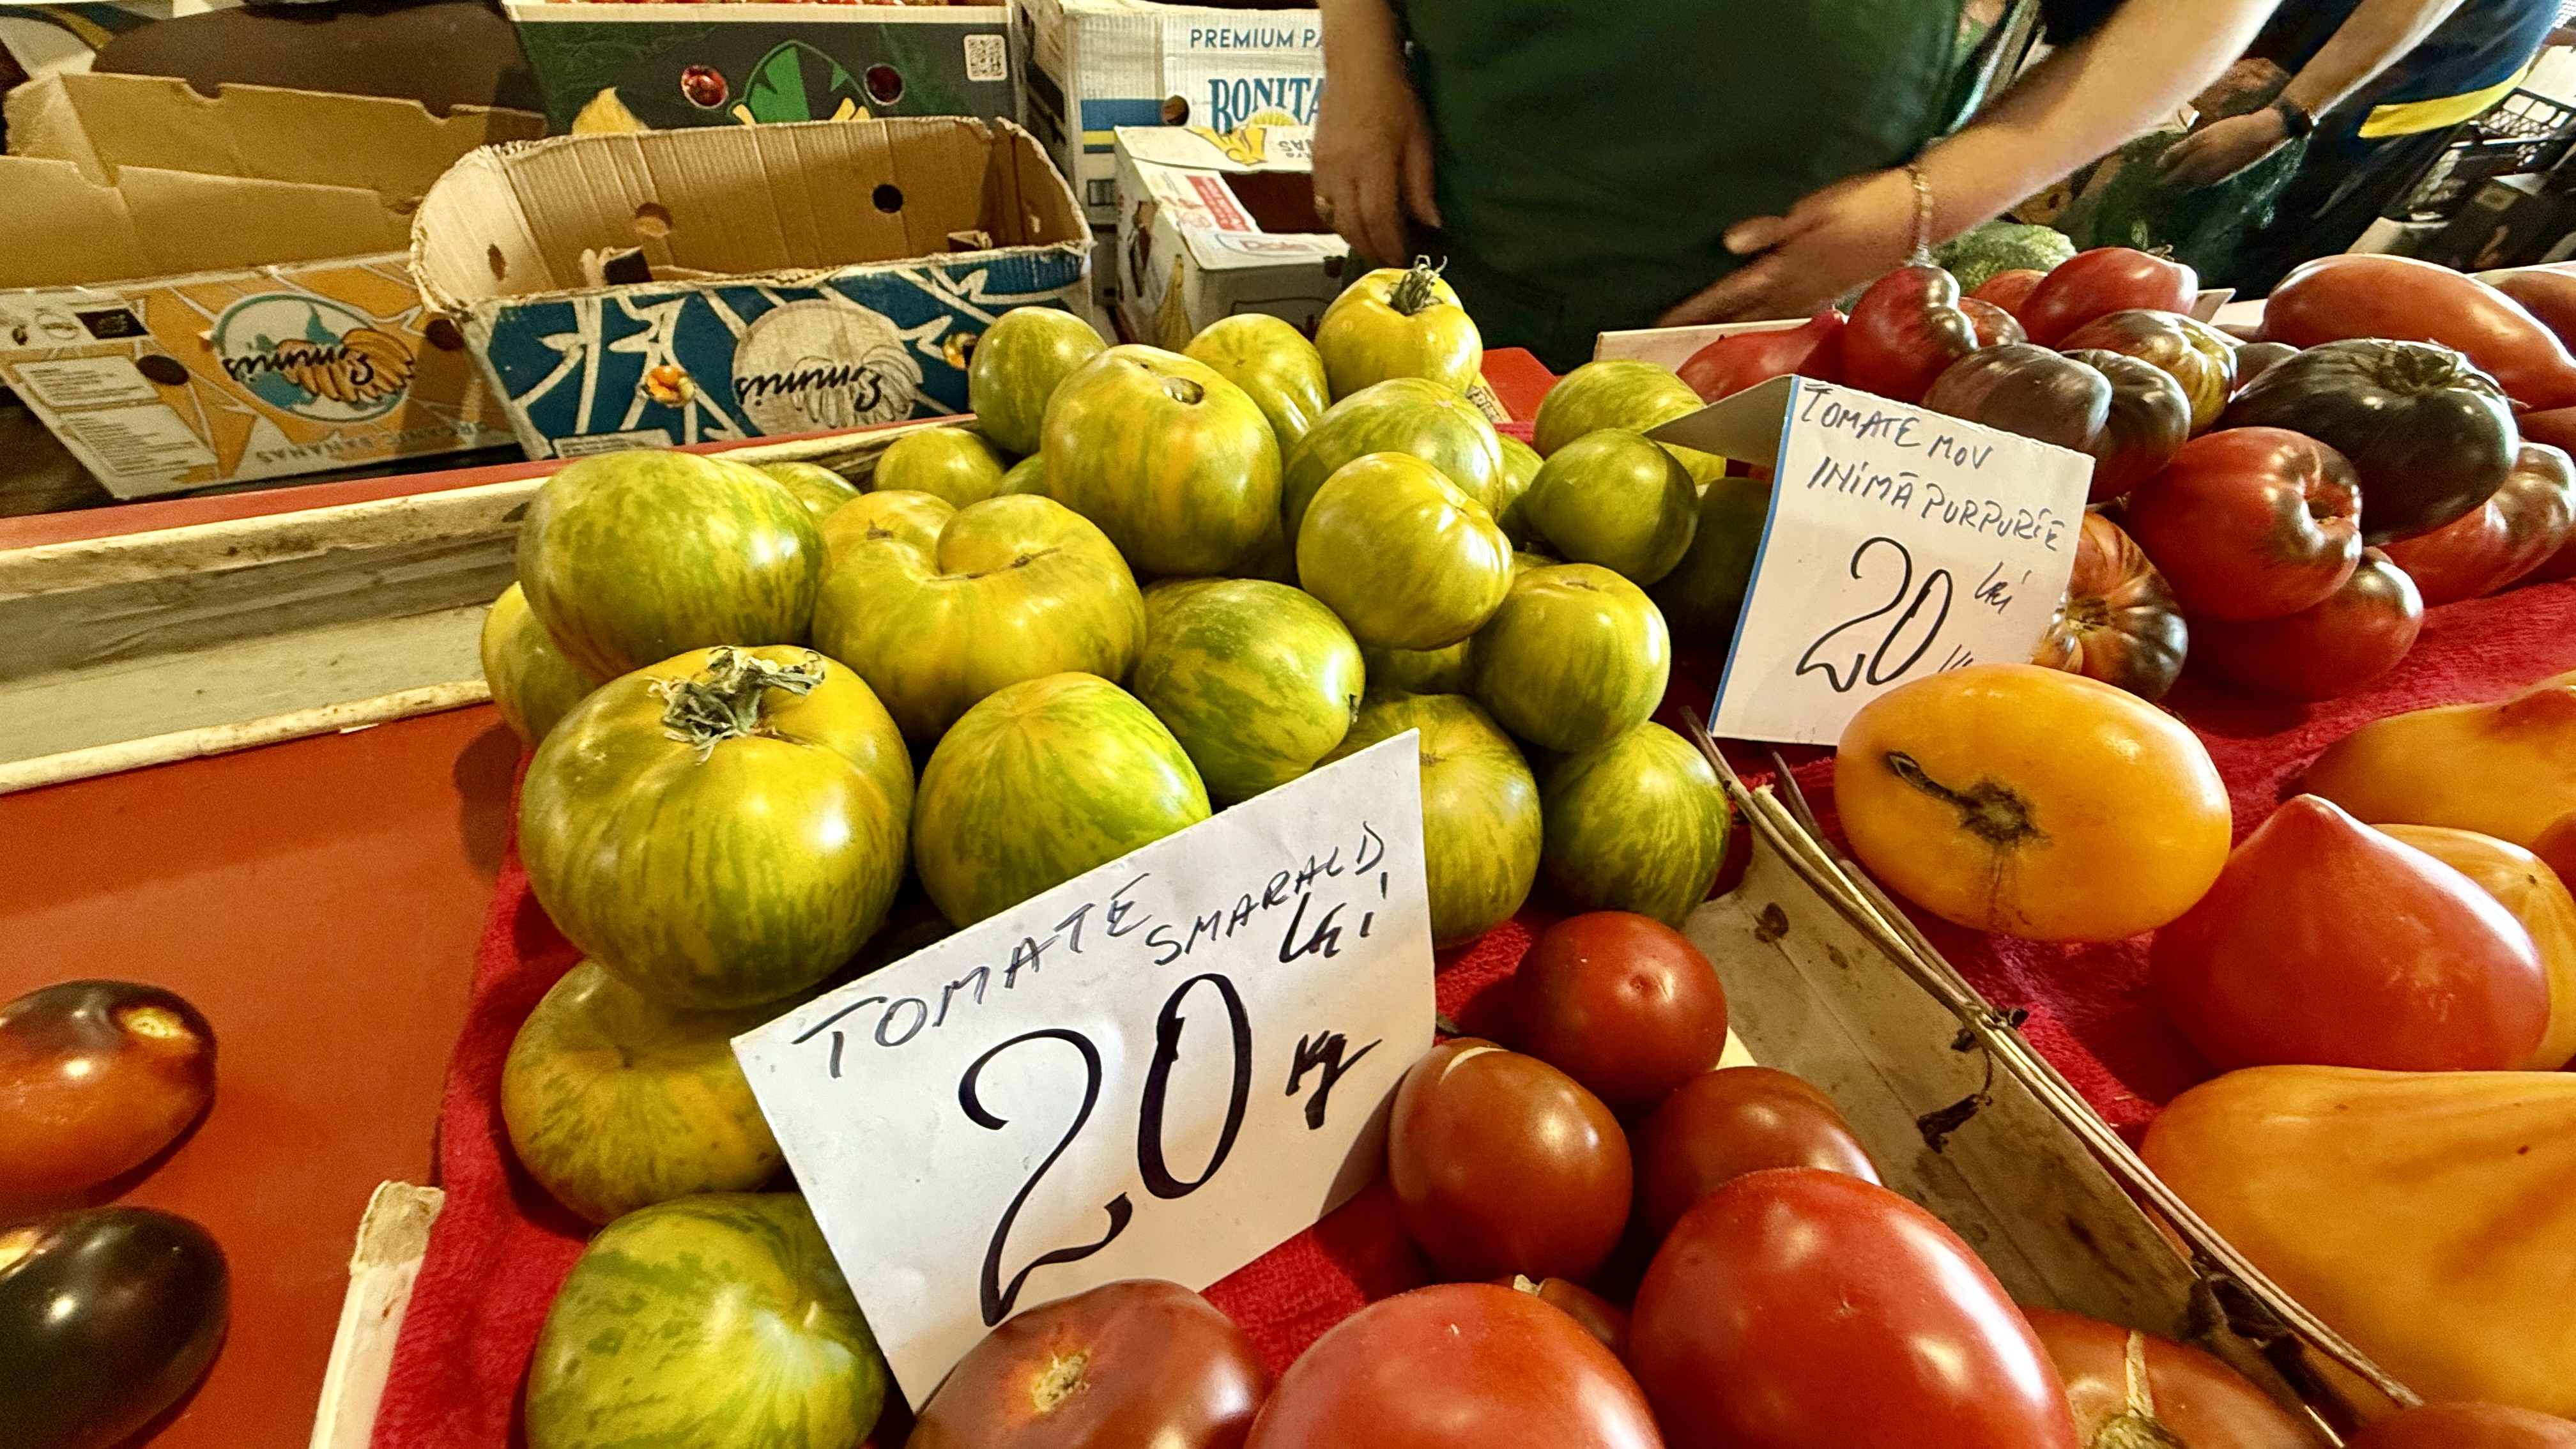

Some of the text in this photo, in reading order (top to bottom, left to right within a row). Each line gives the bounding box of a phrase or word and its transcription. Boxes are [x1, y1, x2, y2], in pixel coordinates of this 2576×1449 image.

[1190, 28, 1294, 49] PREMIUM
[734, 365, 882, 412] Emmis
[1800, 383, 1994, 470] TOMATE MOV
[255, 436, 374, 464] BANANAS
[1795, 537, 1953, 693] 20
[790, 820, 1385, 1079] TOMATE SMARALD
[958, 973, 1252, 1327] 20
